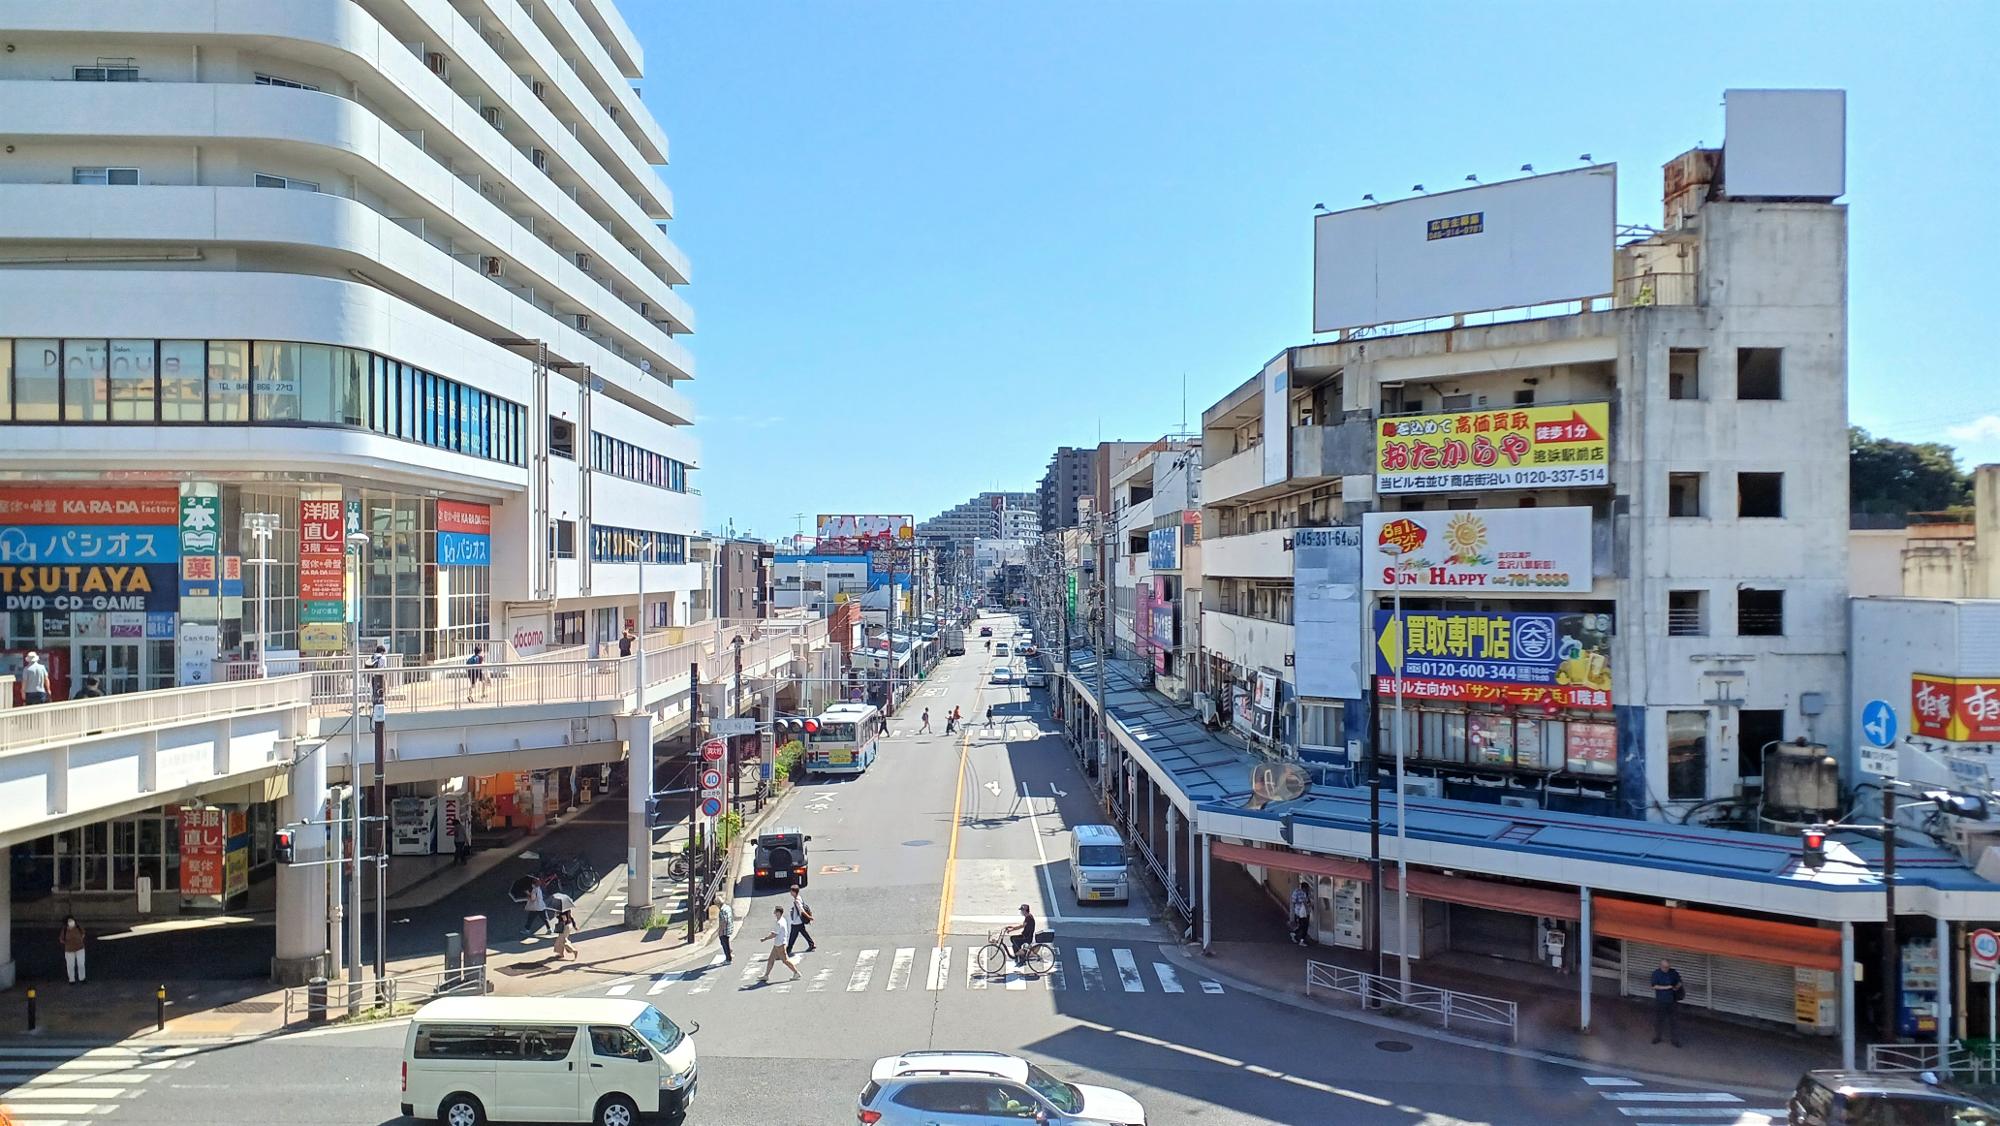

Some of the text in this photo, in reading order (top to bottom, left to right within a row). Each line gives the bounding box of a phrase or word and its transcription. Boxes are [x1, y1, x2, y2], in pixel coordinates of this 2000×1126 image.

[1455, 411, 1529, 434] 高価買取
[1536, 423, 1588, 440] 徒歩1分
[1382, 432, 1530, 470] おたからや
[1380, 469, 1604, 489] 当ビル右並び 商店街沿い 0120-337-514
[187, 498, 211, 506] 2F
[303, 502, 339, 520] 洋服
[183, 504, 216, 531] 本
[347, 509, 359, 533] 本
[303, 522, 339, 540] 直し
[44, 531, 157, 557] パシオス
[456, 538, 486, 560] パシオス
[187, 557, 212, 578] 薬
[1383, 567, 1488, 586] SUN HAPPY
[0, 566, 151, 593] TSUTAYA
[6, 596, 146, 611] DVD CD GAME
[514, 629, 543, 648] docomo
[1406, 615, 1511, 659] 買取専門店
[1520, 627, 1547, 653] 大吉
[1421, 662, 1516, 680] 0120-600-344
[706, 775, 718, 784] 40
[184, 811, 220, 828] 洋服
[446, 800, 456, 837] KIRIN
[184, 829, 218, 846] 直し
